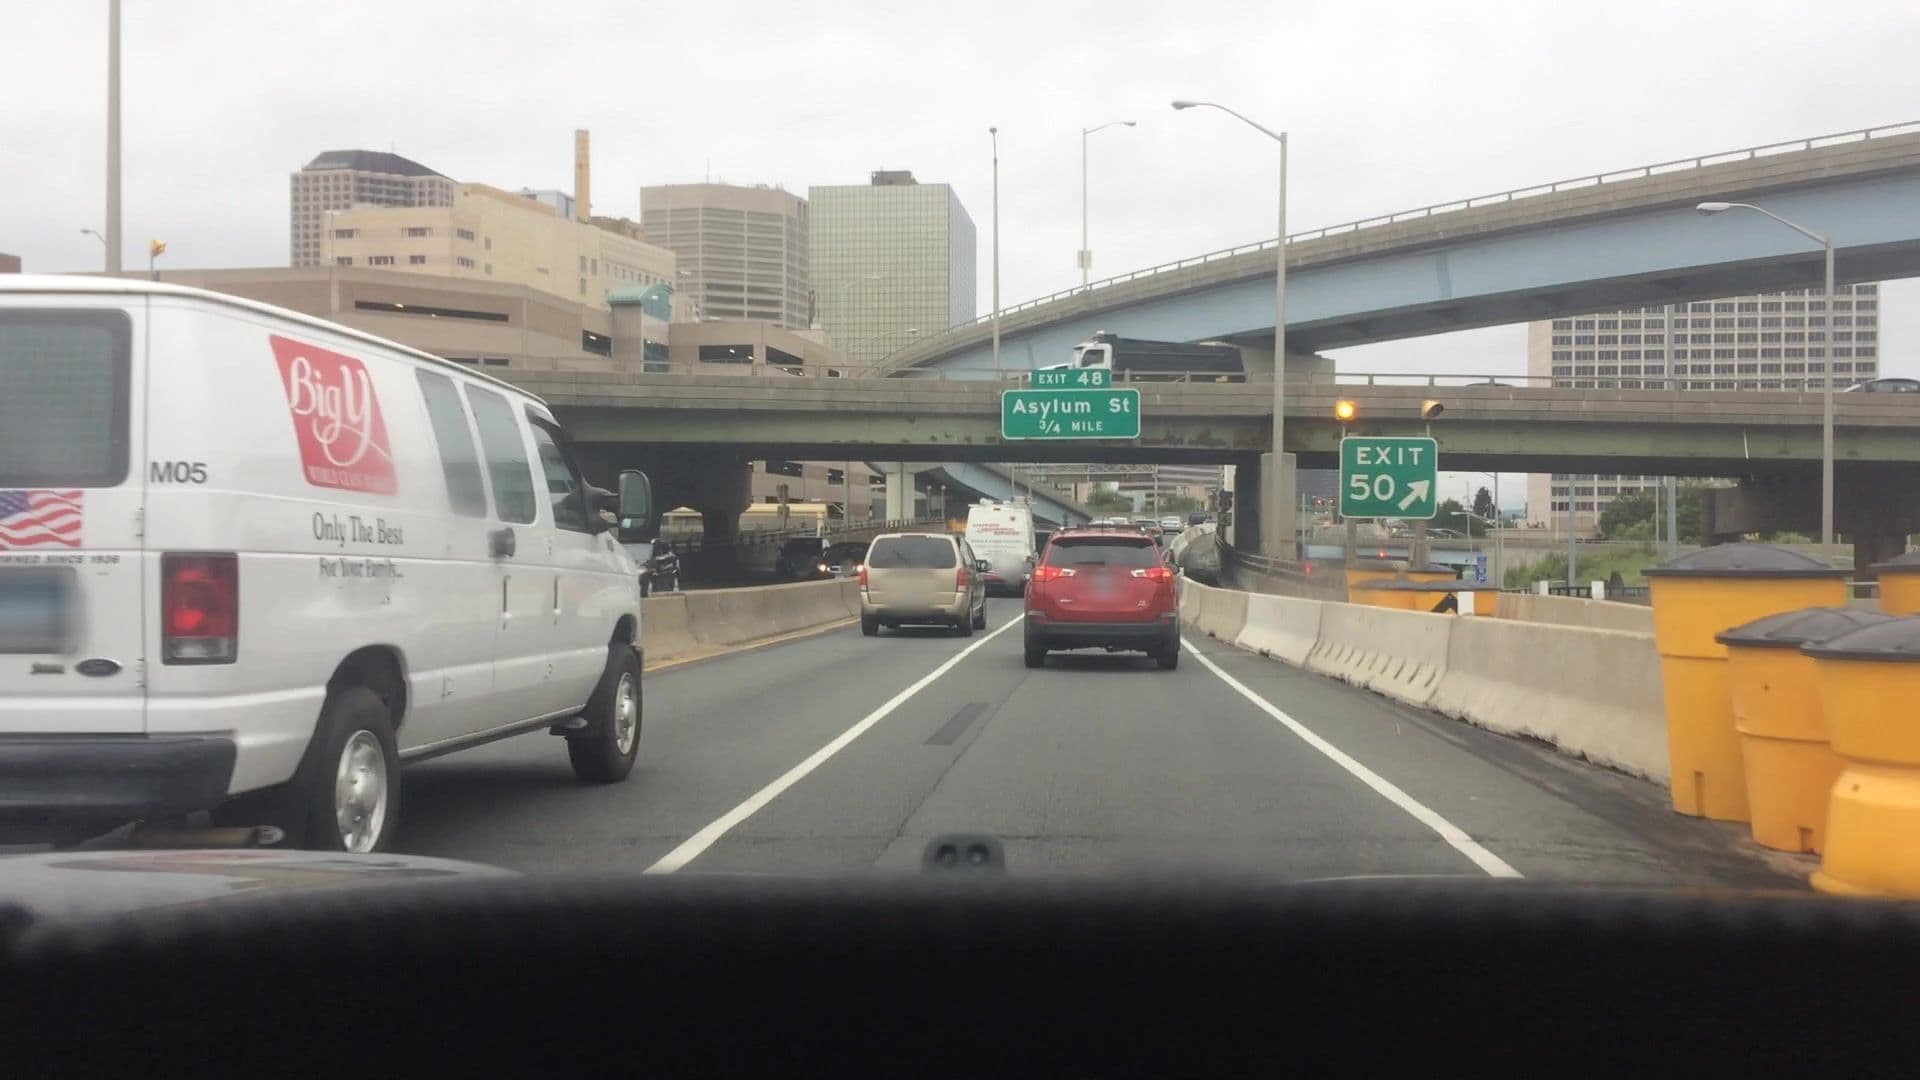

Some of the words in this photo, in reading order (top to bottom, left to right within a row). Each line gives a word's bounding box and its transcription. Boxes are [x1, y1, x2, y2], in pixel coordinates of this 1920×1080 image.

[1038, 374, 1067, 385] EXIT
[1077, 371, 1103, 385] 48
[1011, 398, 1091, 419] Asylum
[1109, 397, 1130, 413] St
[1071, 421, 1104, 432] MILE
[1356, 446, 1424, 465] EXIT
[150, 461, 207, 484] M05
[1349, 473, 1395, 501] 50
[313, 512, 346, 548] Only
[349, 516, 374, 544] The
[376, 518, 404, 545] Best
[319, 557, 336, 577] For
